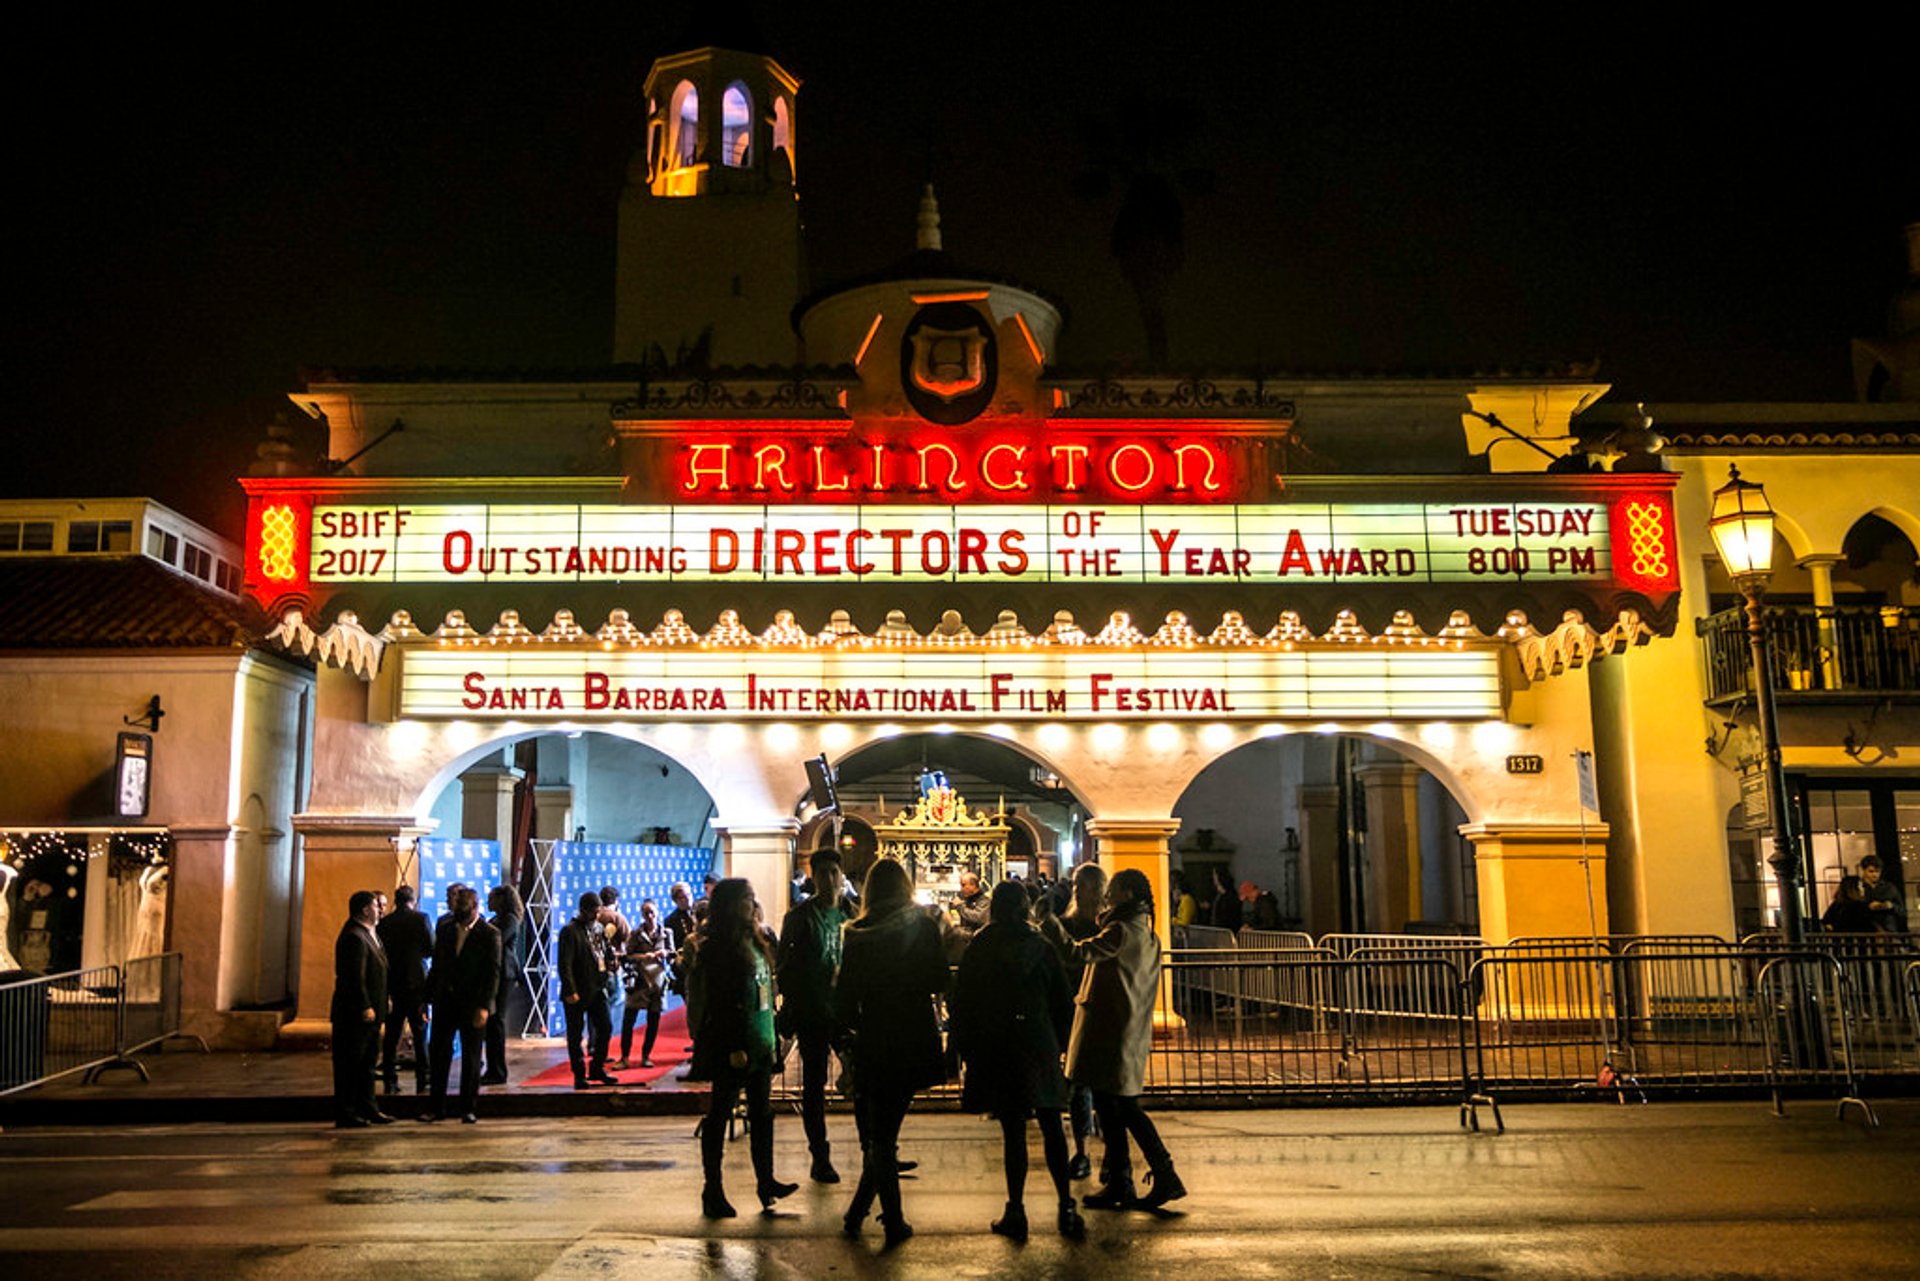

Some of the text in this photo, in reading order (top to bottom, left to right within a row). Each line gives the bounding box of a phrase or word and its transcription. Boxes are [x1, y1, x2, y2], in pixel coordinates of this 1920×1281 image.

[684, 444, 1221, 492] ARLINGTON
[320, 510, 413, 538] SBIFF
[1062, 511, 1106, 538] OF
[1449, 508, 1595, 537] TUESDAY
[316, 549, 387, 576] 2017
[442, 527, 1030, 576] OUTSTANDING DIRECTORS
[1057, 549, 1122, 576] THE
[1149, 529, 1416, 577] YEAR AWARD
[1467, 547, 1597, 575] 800 PM
[462, 672, 1237, 712] SANTA BARBARA INTERNATIONAL FILM FESTIVAL
[1509, 757, 1540, 772] 1317
